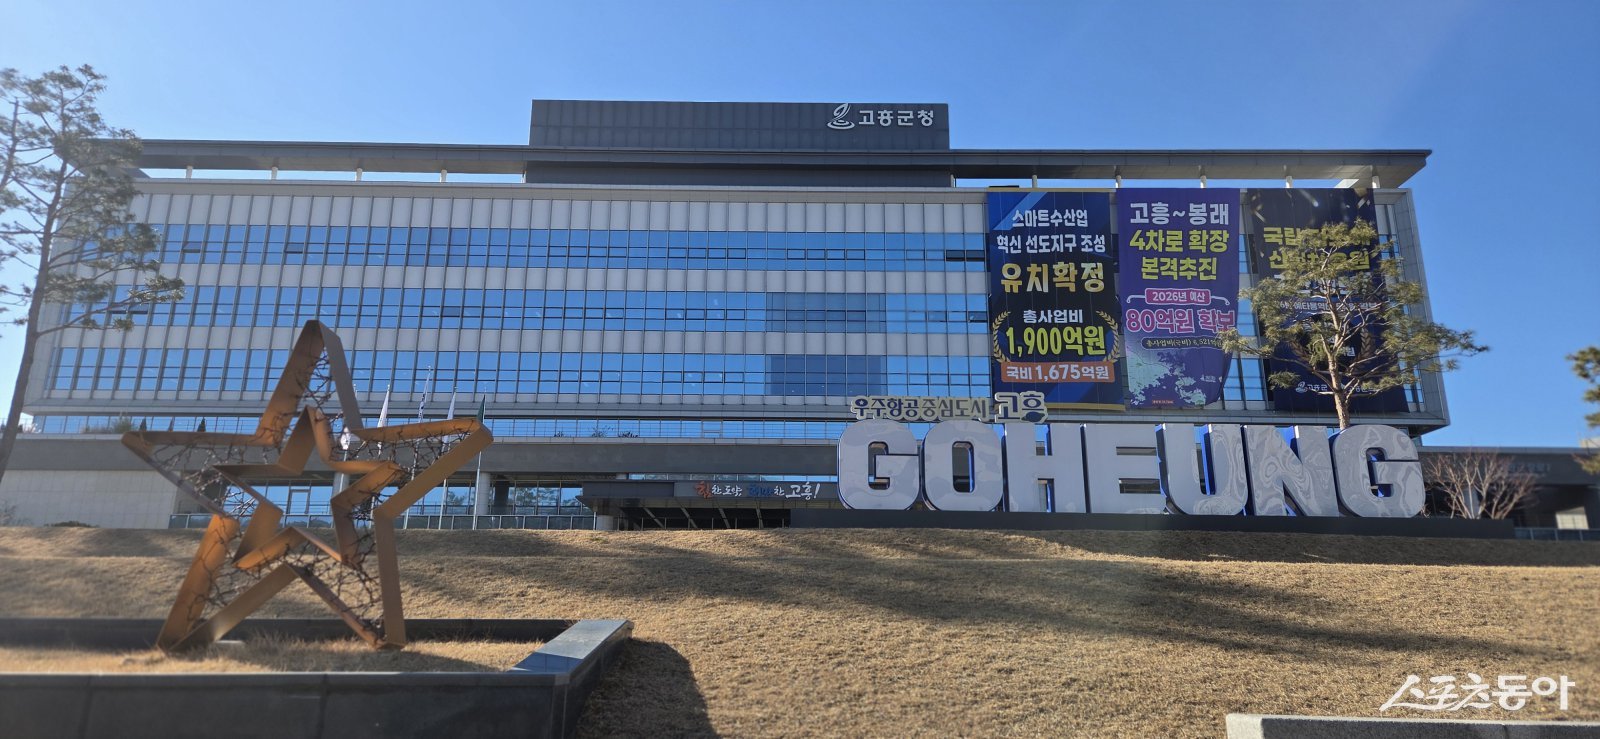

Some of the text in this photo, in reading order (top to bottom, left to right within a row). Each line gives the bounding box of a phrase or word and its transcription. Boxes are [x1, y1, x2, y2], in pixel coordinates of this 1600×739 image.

[859, 109, 934, 127] 고흥군청
[1012, 209, 1088, 228] 스마트수산업
[1130, 202, 1229, 225] 고흥~봉래
[996, 234, 1106, 254] 혁신 선도지구 조성
[1129, 229, 1230, 253] 4차로 확장
[1001, 261, 1105, 293] 유치확정
[1141, 256, 1217, 281] 본격추진
[1152, 291, 1188, 302] 2026년
[1023, 309, 1084, 324] 총사업비
[1126, 308, 1235, 334] 80억원 확보
[1006, 326, 1106, 358] 1,900억원
[1006, 364, 1110, 382] 국비 1,675억원
[997, 393, 1046, 423] 고흥
[838, 420, 1425, 518] GOHEUNG
[785, 481, 820, 500] 고흥!
